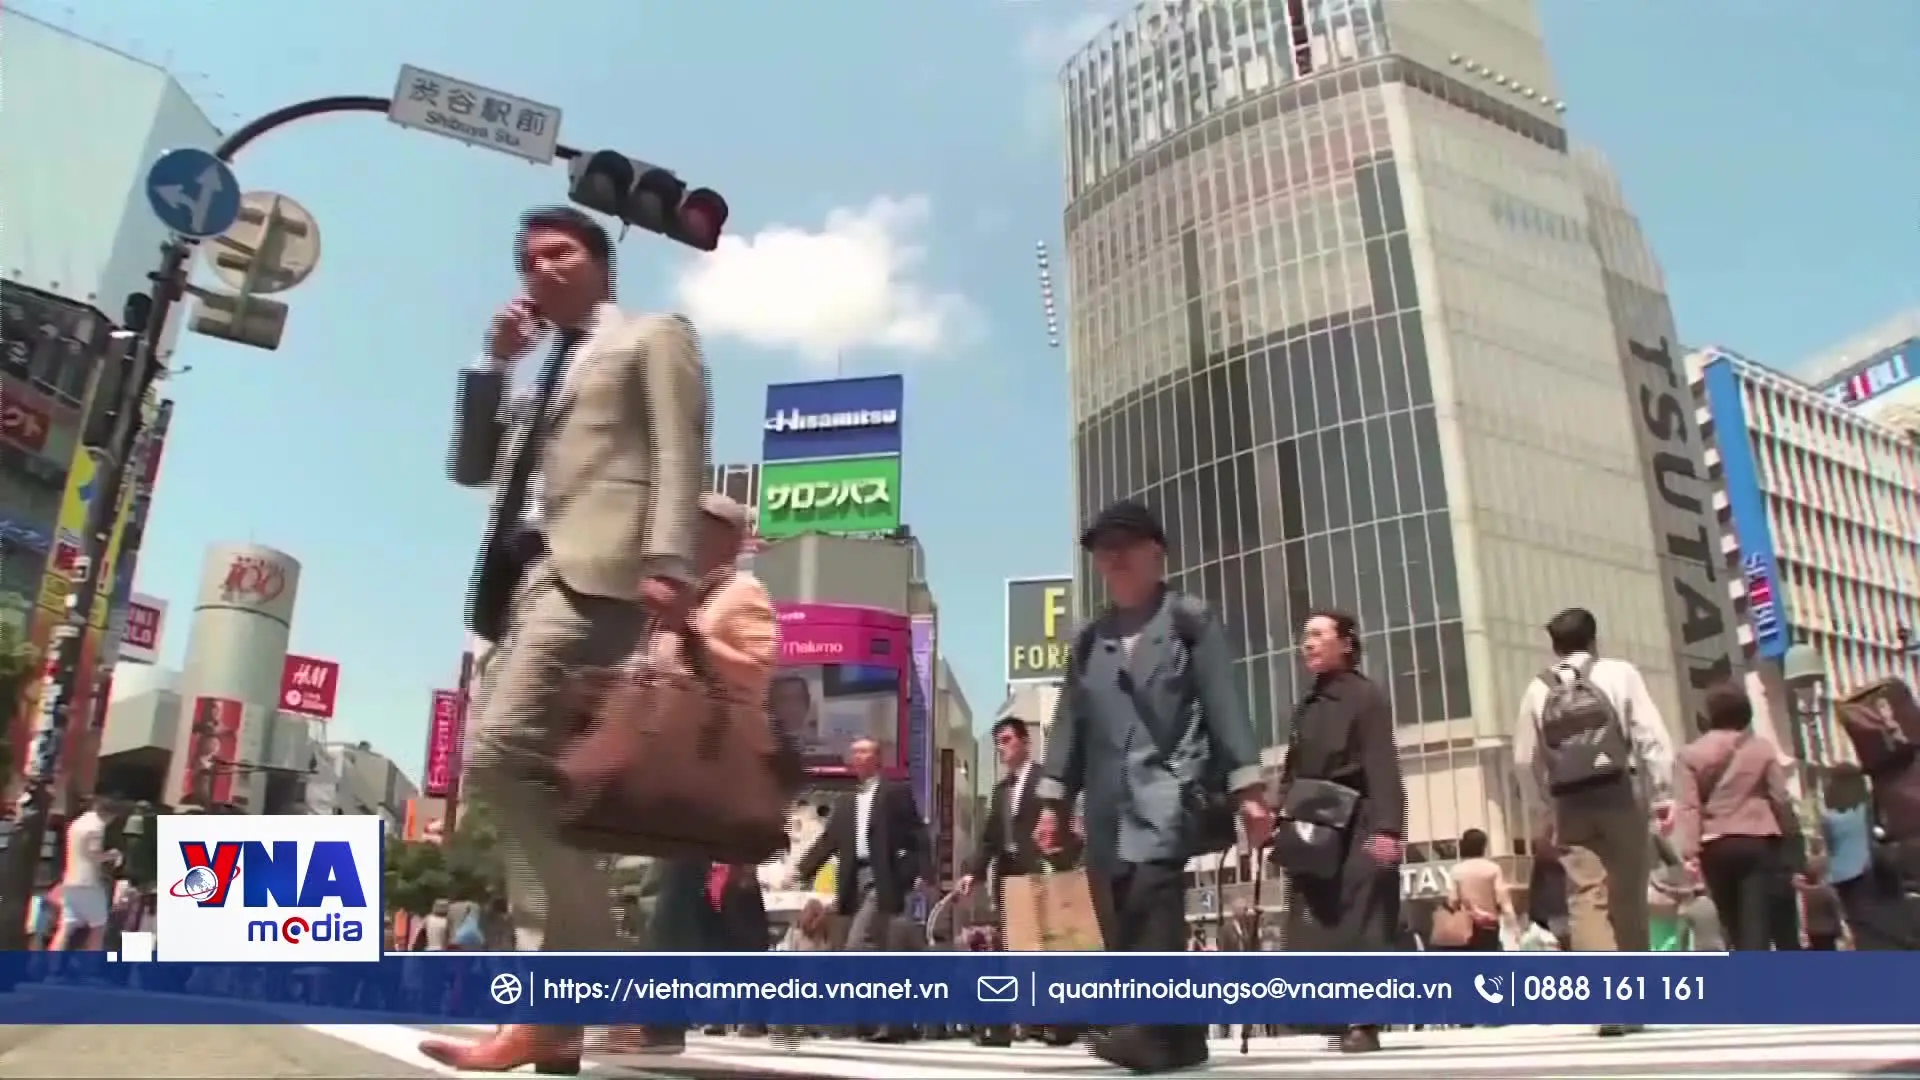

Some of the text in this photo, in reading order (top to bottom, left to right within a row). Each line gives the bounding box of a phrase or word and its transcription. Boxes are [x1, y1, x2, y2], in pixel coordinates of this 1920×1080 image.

[409, 78, 545, 136] 渋谷駅前
[424, 110, 488, 138] Shibuya
